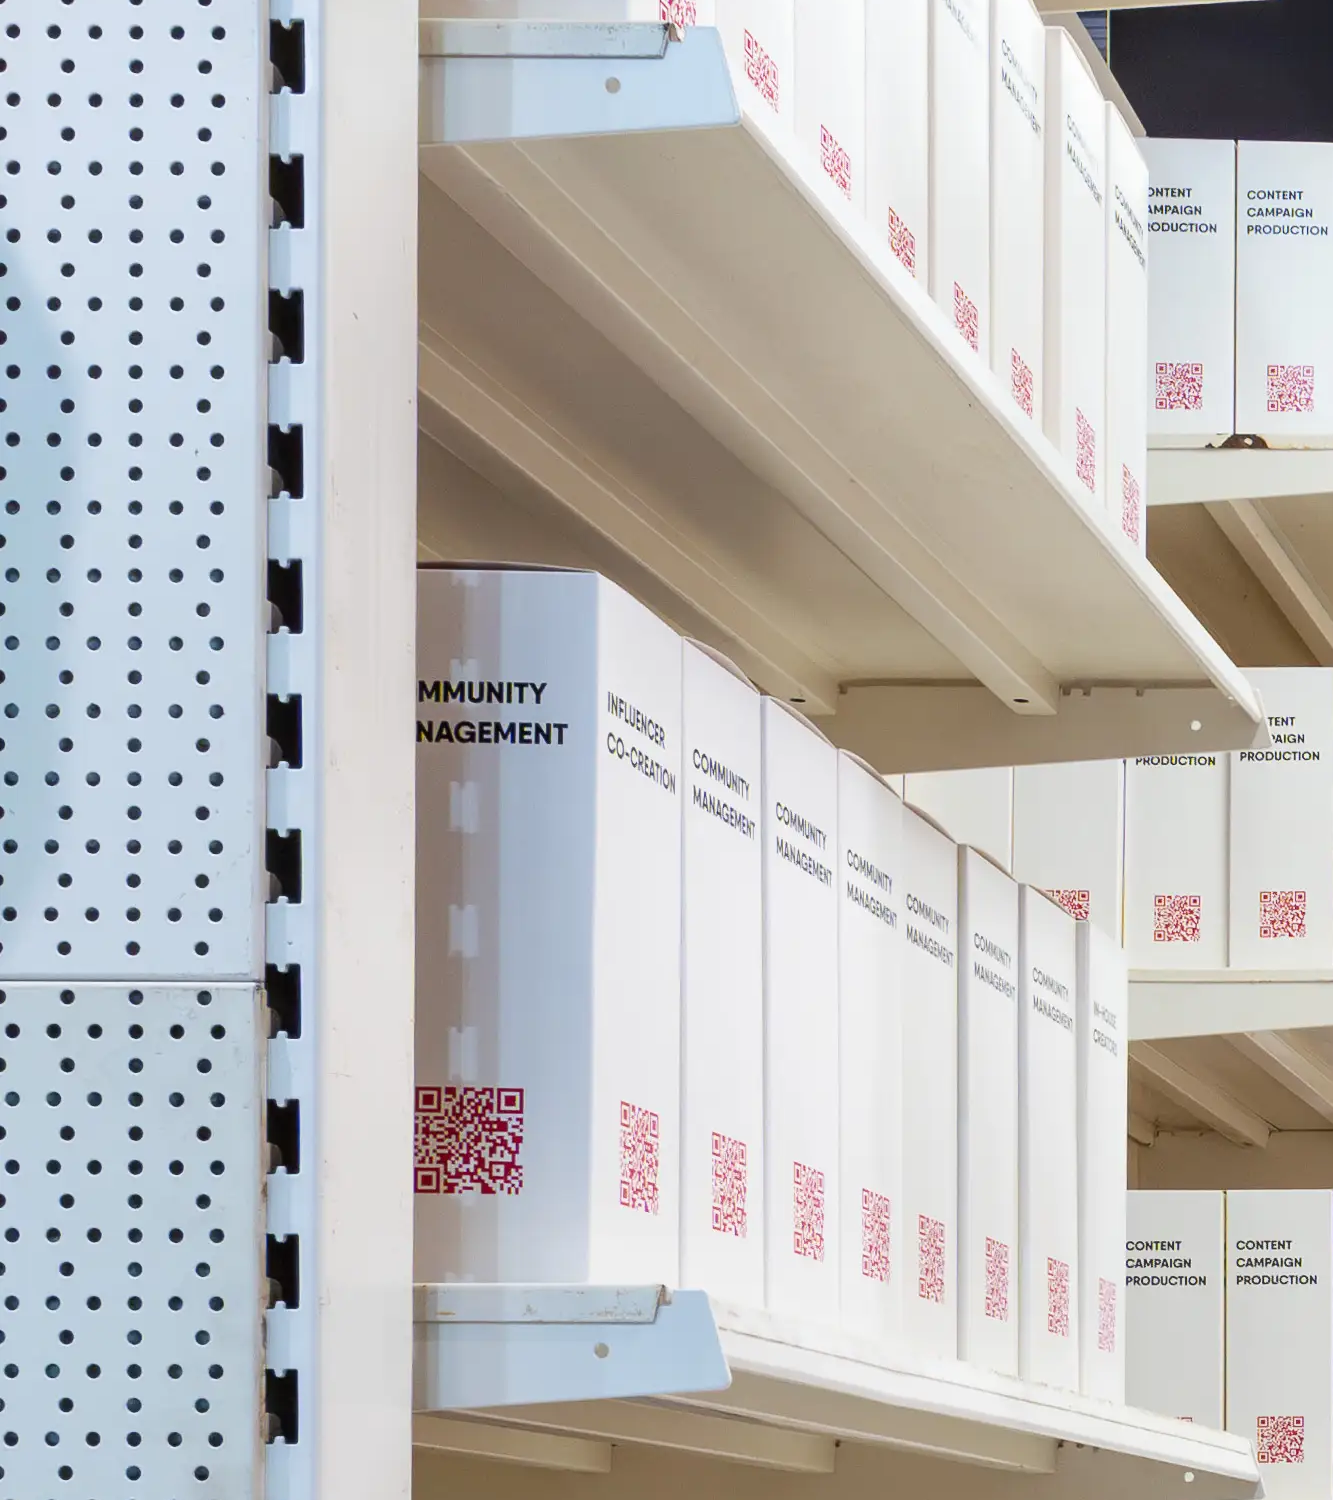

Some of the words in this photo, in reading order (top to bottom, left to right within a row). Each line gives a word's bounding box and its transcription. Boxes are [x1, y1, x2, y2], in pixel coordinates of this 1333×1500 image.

[1246, 189, 1303, 200] CONTENT
[1246, 207, 1313, 217] CAMPAIGN
[1246, 224, 1328, 235] PRODUCTION
[607, 691, 665, 749] INFLUENCER
[606, 731, 675, 794] CO-CREATION
[692, 748, 749, 797] COMMUNITY
[692, 784, 755, 838] MANAGEMENT
[775, 801, 826, 849] COMMUNITY
[776, 836, 832, 885] MANAGEMENT
[1235, 1239, 1292, 1250] CONTENT
[1235, 1257, 1302, 1267] CAMPAIGN
[1236, 1274, 1317, 1285] PRODUCTION
